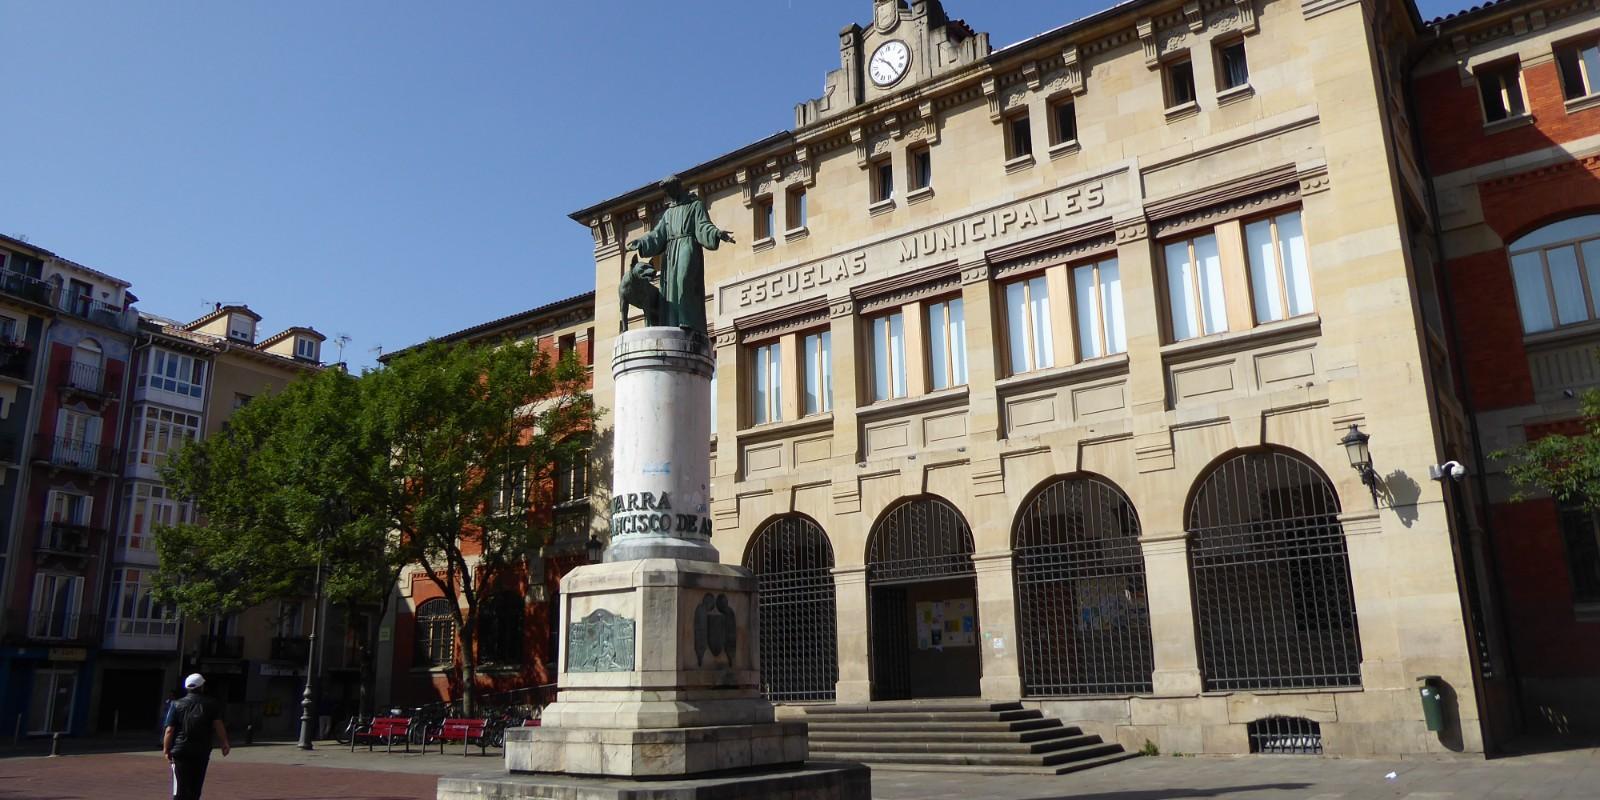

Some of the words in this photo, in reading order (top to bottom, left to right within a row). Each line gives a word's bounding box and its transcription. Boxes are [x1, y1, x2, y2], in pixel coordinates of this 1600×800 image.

[739, 251, 867, 307] ESCUELAS
[899, 182, 1105, 263] MUNICIPALES
[675, 513, 698, 533] DE
